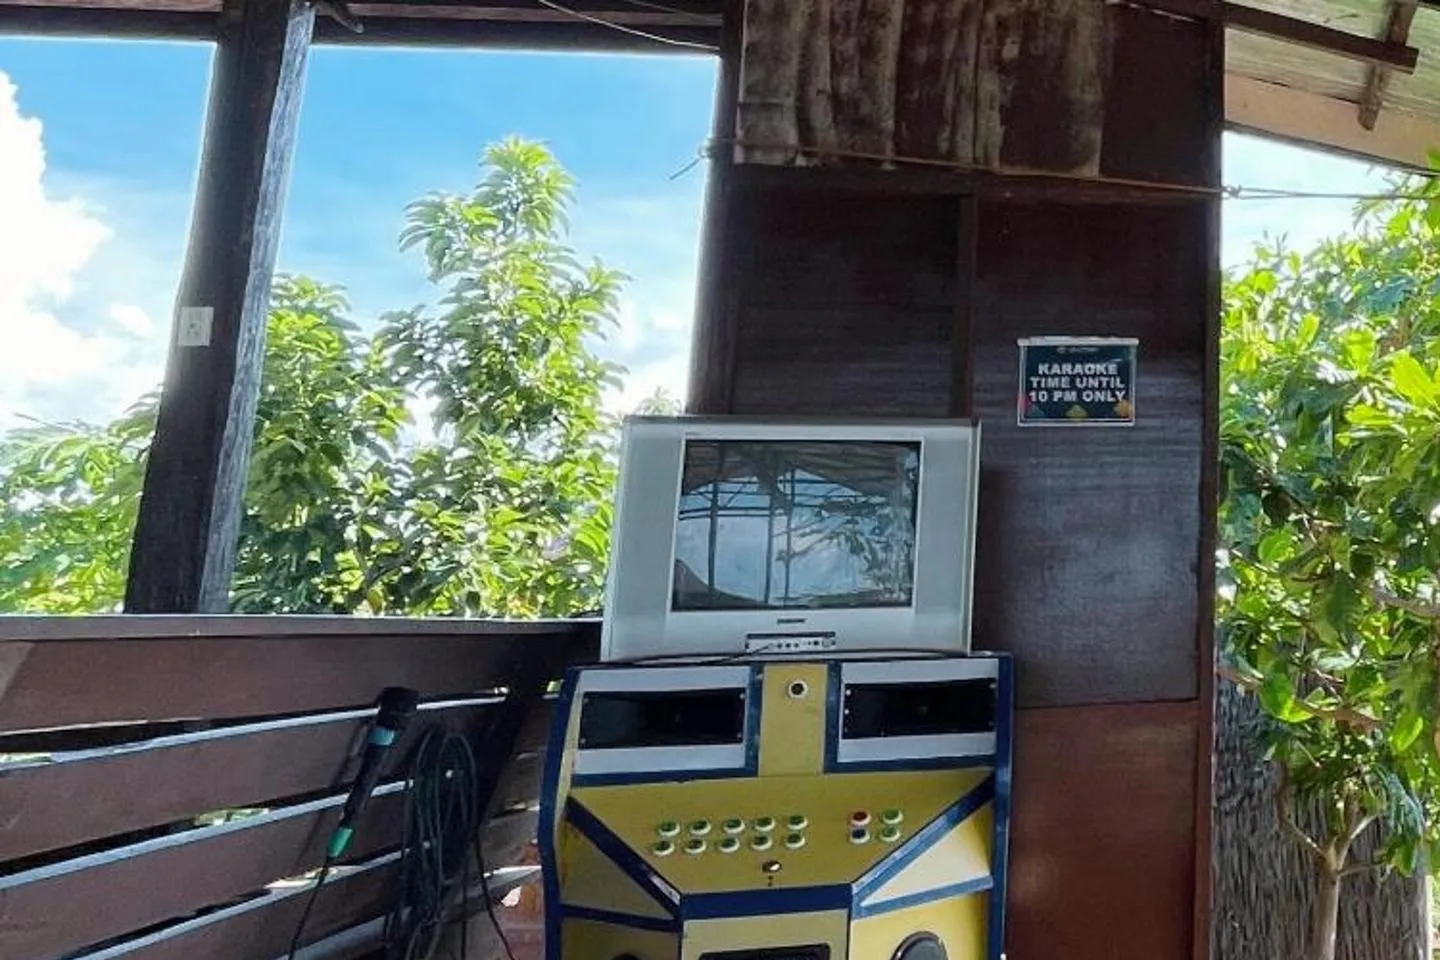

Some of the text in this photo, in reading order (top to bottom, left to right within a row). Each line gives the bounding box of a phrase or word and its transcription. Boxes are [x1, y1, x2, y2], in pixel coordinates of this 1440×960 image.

[1038, 363, 1118, 375] KARAOKE
[1030, 377, 1125, 388] TIME UNTIL
[1028, 390, 1126, 402] 10 PM ONLY
